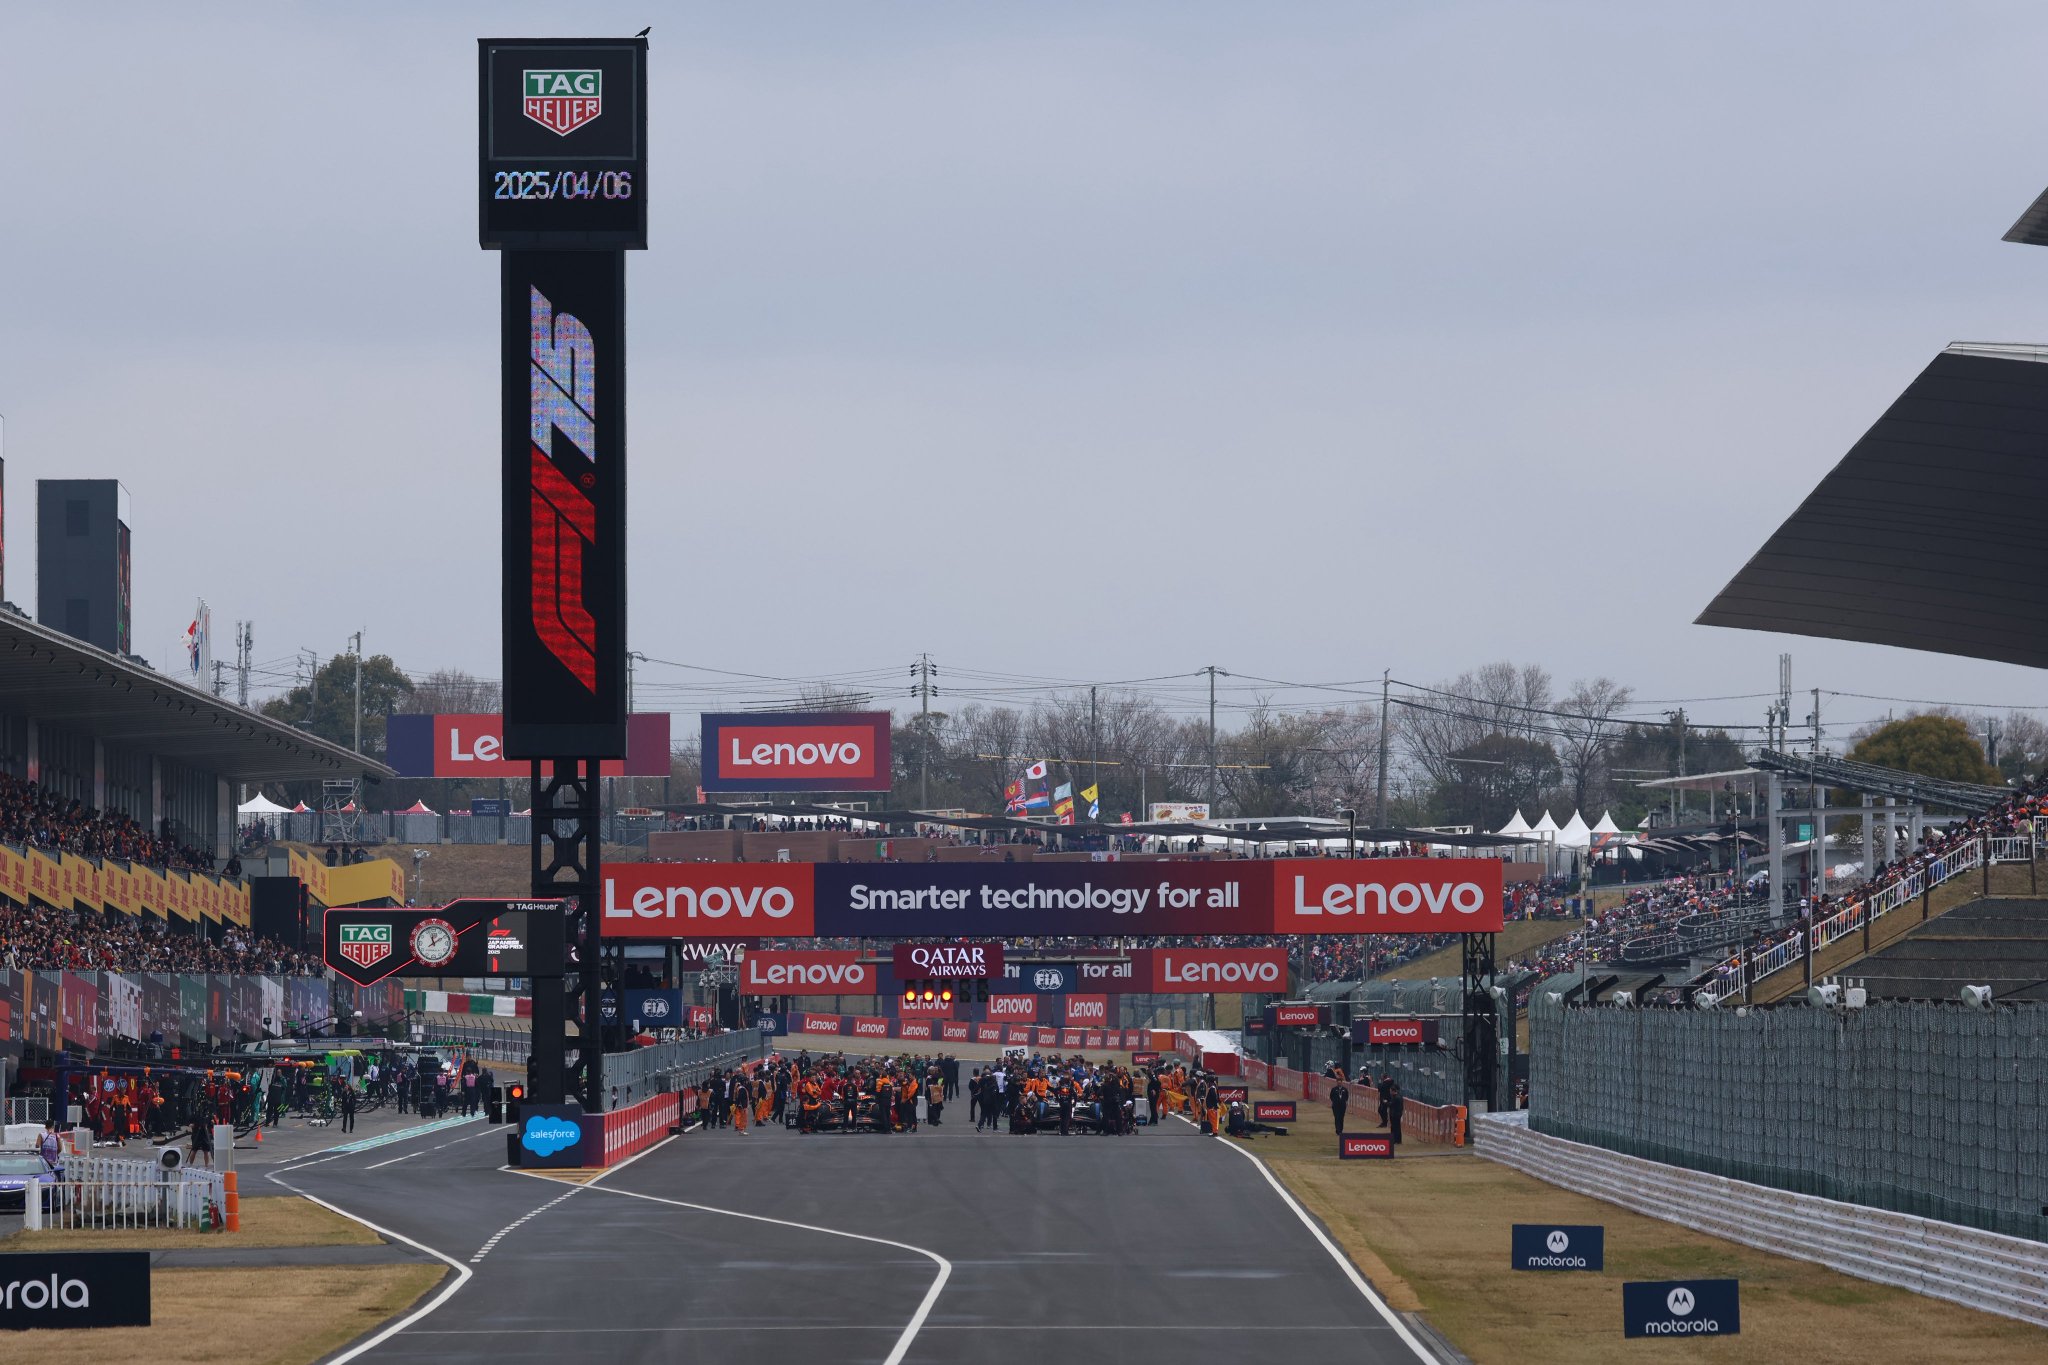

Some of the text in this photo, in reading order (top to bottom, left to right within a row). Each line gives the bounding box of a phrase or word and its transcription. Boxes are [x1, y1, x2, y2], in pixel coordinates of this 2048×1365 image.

[530, 74, 595, 94] TAG
[528, 100, 597, 131] HEUER
[494, 171, 632, 200] 2025/04/06
[451, 728, 505, 761] Le
[732, 738, 861, 766] Lenovo
[605, 878, 795, 919] Lenovo
[849, 881, 1240, 914] Smarter technology for all
[1294, 875, 1484, 916] Lenovo
[344, 927, 387, 941] TAG
[343, 943, 389, 967] HEUER
[911, 948, 985, 968] QATAR
[750, 959, 865, 984] Lenovo
[929, 965, 987, 976] AIRWAYS
[1082, 963, 1132, 978] for all
[1164, 957, 1279, 982] Lenovo
[643, 1001, 668, 1014] FIA
[990, 995, 1033, 1014] Lenovo
[1068, 998, 1104, 1017] Lenovo
[1279, 1010, 1315, 1021] Lenovo
[806, 1017, 838, 1031] Lenovo
[856, 1021, 885, 1034] Lenovo
[902, 1023, 930, 1036] Lenovo
[1373, 1024, 1418, 1037] Lenovo
[943, 1025, 967, 1038] Lenovo
[979, 1027, 1000, 1039] Lenovo
[1009, 1029, 1028, 1042] Lenovo
[1038, 1031, 1056, 1044] Lenovo
[1064, 1034, 1080, 1045] Lenovo
[1086, 1034, 1102, 1046] Lenovo
[1005, 1048, 1026, 1057] DRS
[1260, 1108, 1290, 1116] Lenovo
[530, 1129, 575, 1140] salesforce
[1348, 1142, 1386, 1152] Lenovo
[1528, 1255, 1586, 1267] motorola
[0, 1273, 89, 1309] rola
[1645, 1318, 1718, 1334] motorola
